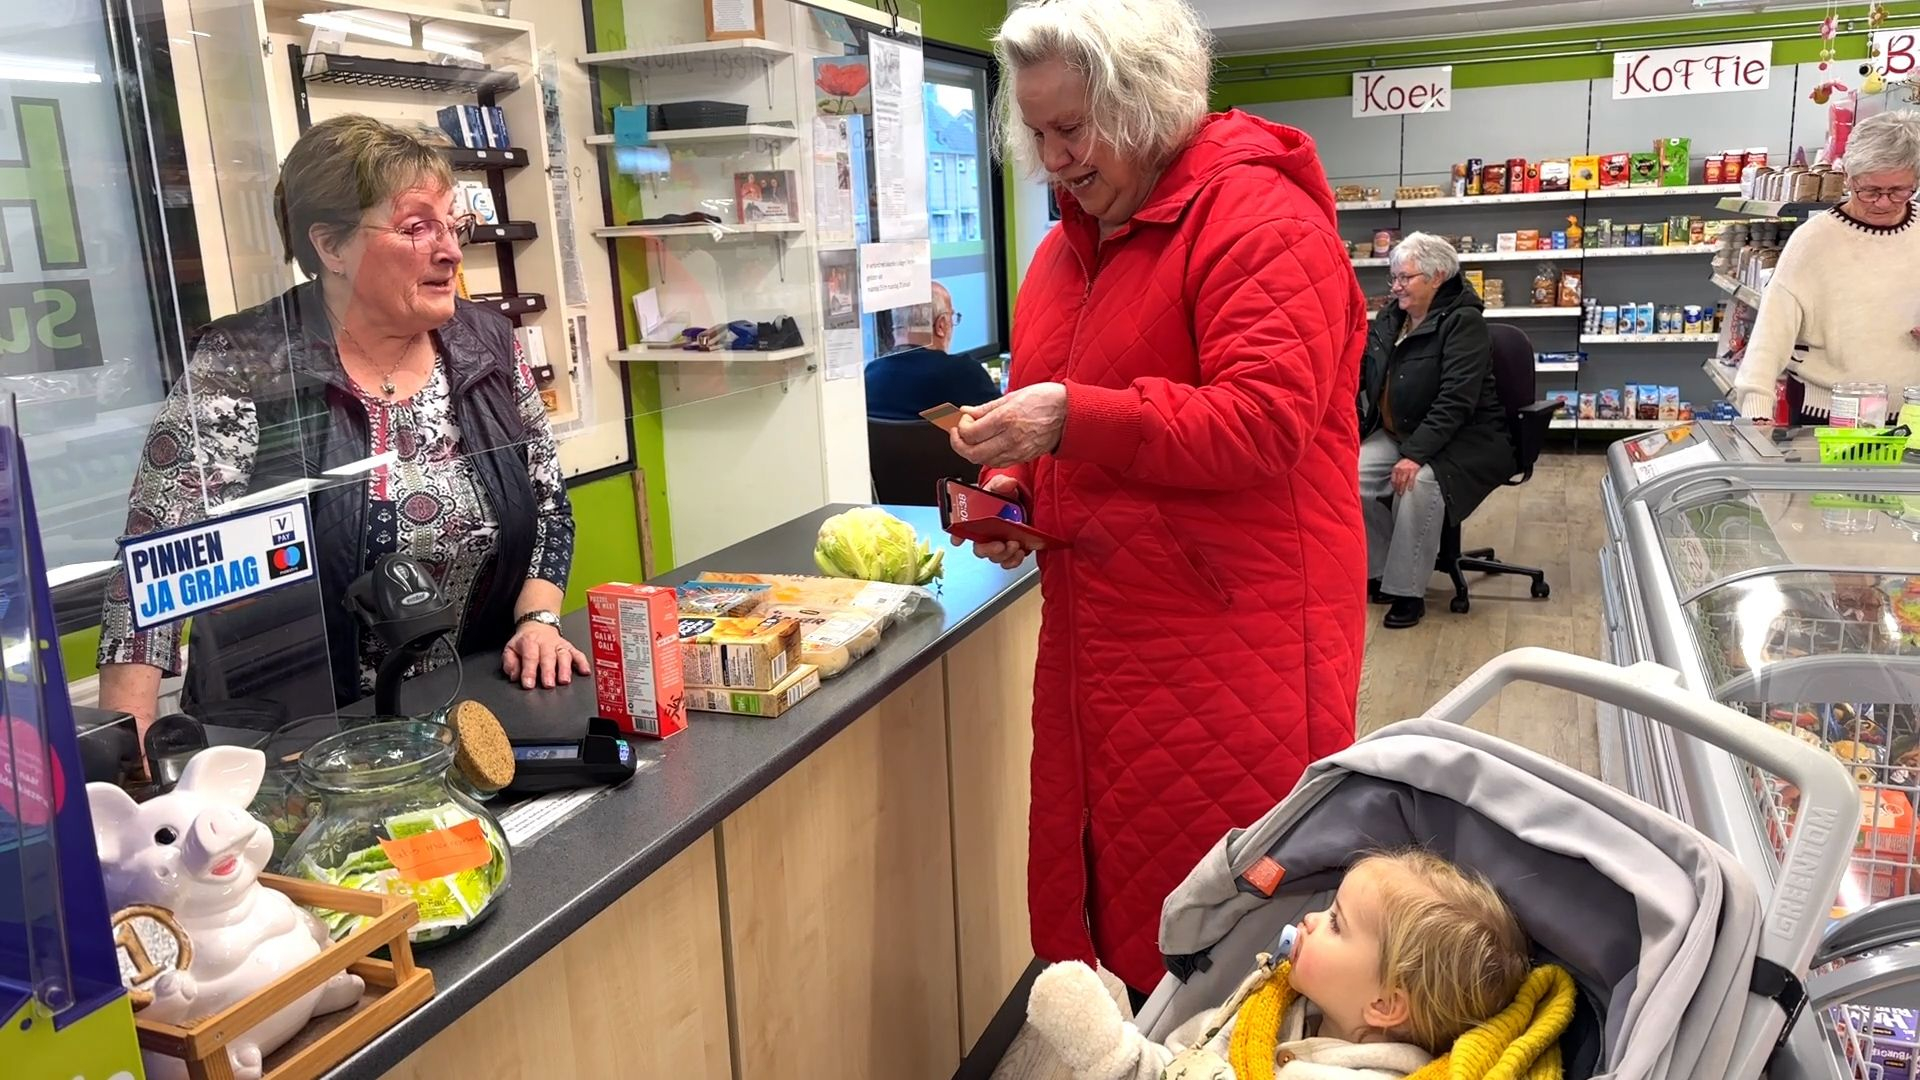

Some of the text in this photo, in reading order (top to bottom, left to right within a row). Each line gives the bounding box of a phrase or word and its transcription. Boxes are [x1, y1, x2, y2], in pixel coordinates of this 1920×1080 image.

[1360, 74, 1445, 113] Koek
[131, 530, 225, 585] PINNEN
[277, 533, 291, 543] PAY
[141, 556, 260, 618] JA GRAAG
[1769, 805, 1839, 941] GREENTOM
